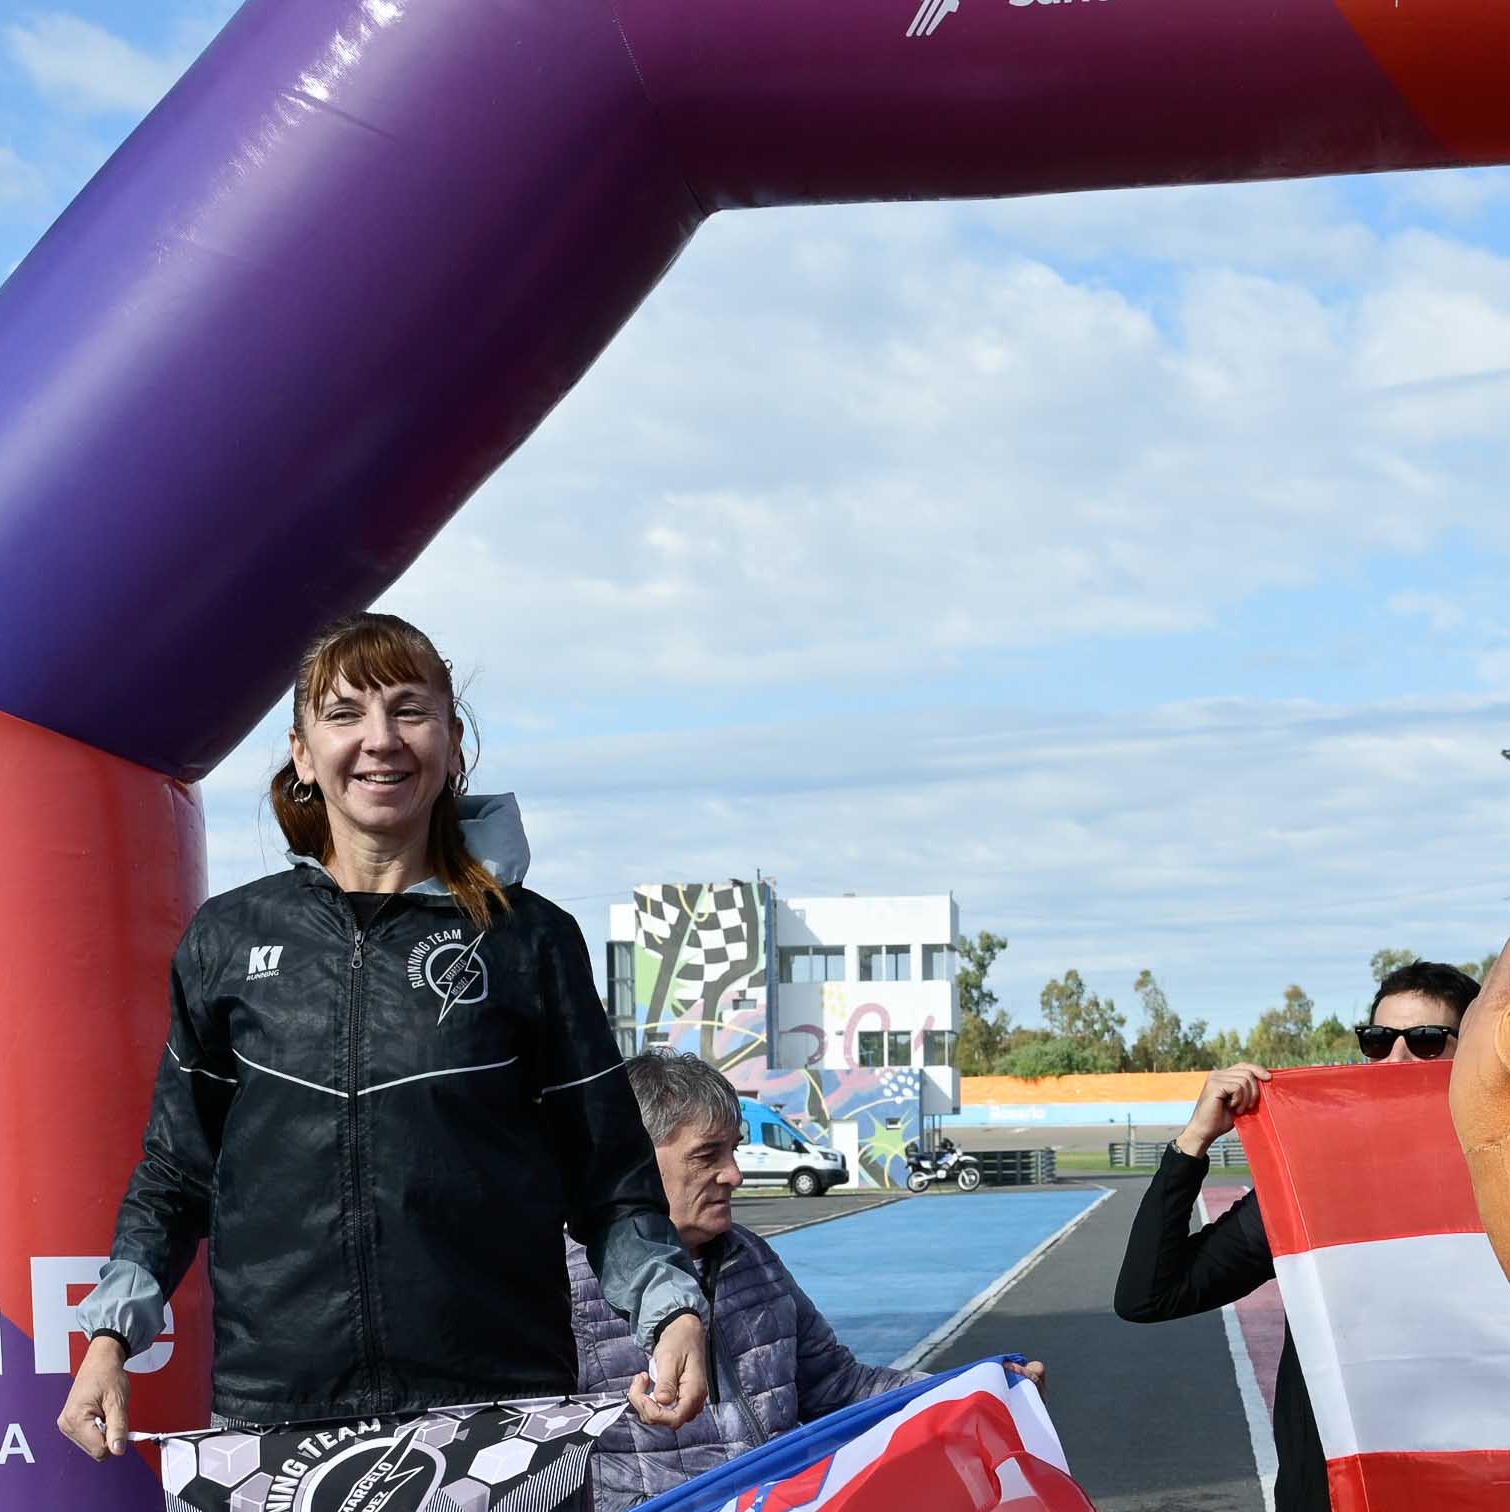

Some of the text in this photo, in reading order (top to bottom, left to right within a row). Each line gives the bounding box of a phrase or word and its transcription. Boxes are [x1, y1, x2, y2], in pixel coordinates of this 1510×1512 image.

[248, 945, 283, 974] K1
[407, 928, 462, 989] RUNNING TEAM
[445, 959, 467, 982] MARCELO
[246, 969, 280, 982] RUNNING
[450, 976, 470, 997] MENDEZ
[30, 1256, 175, 1375] F
[297, 1418, 381, 1458] TEAM
